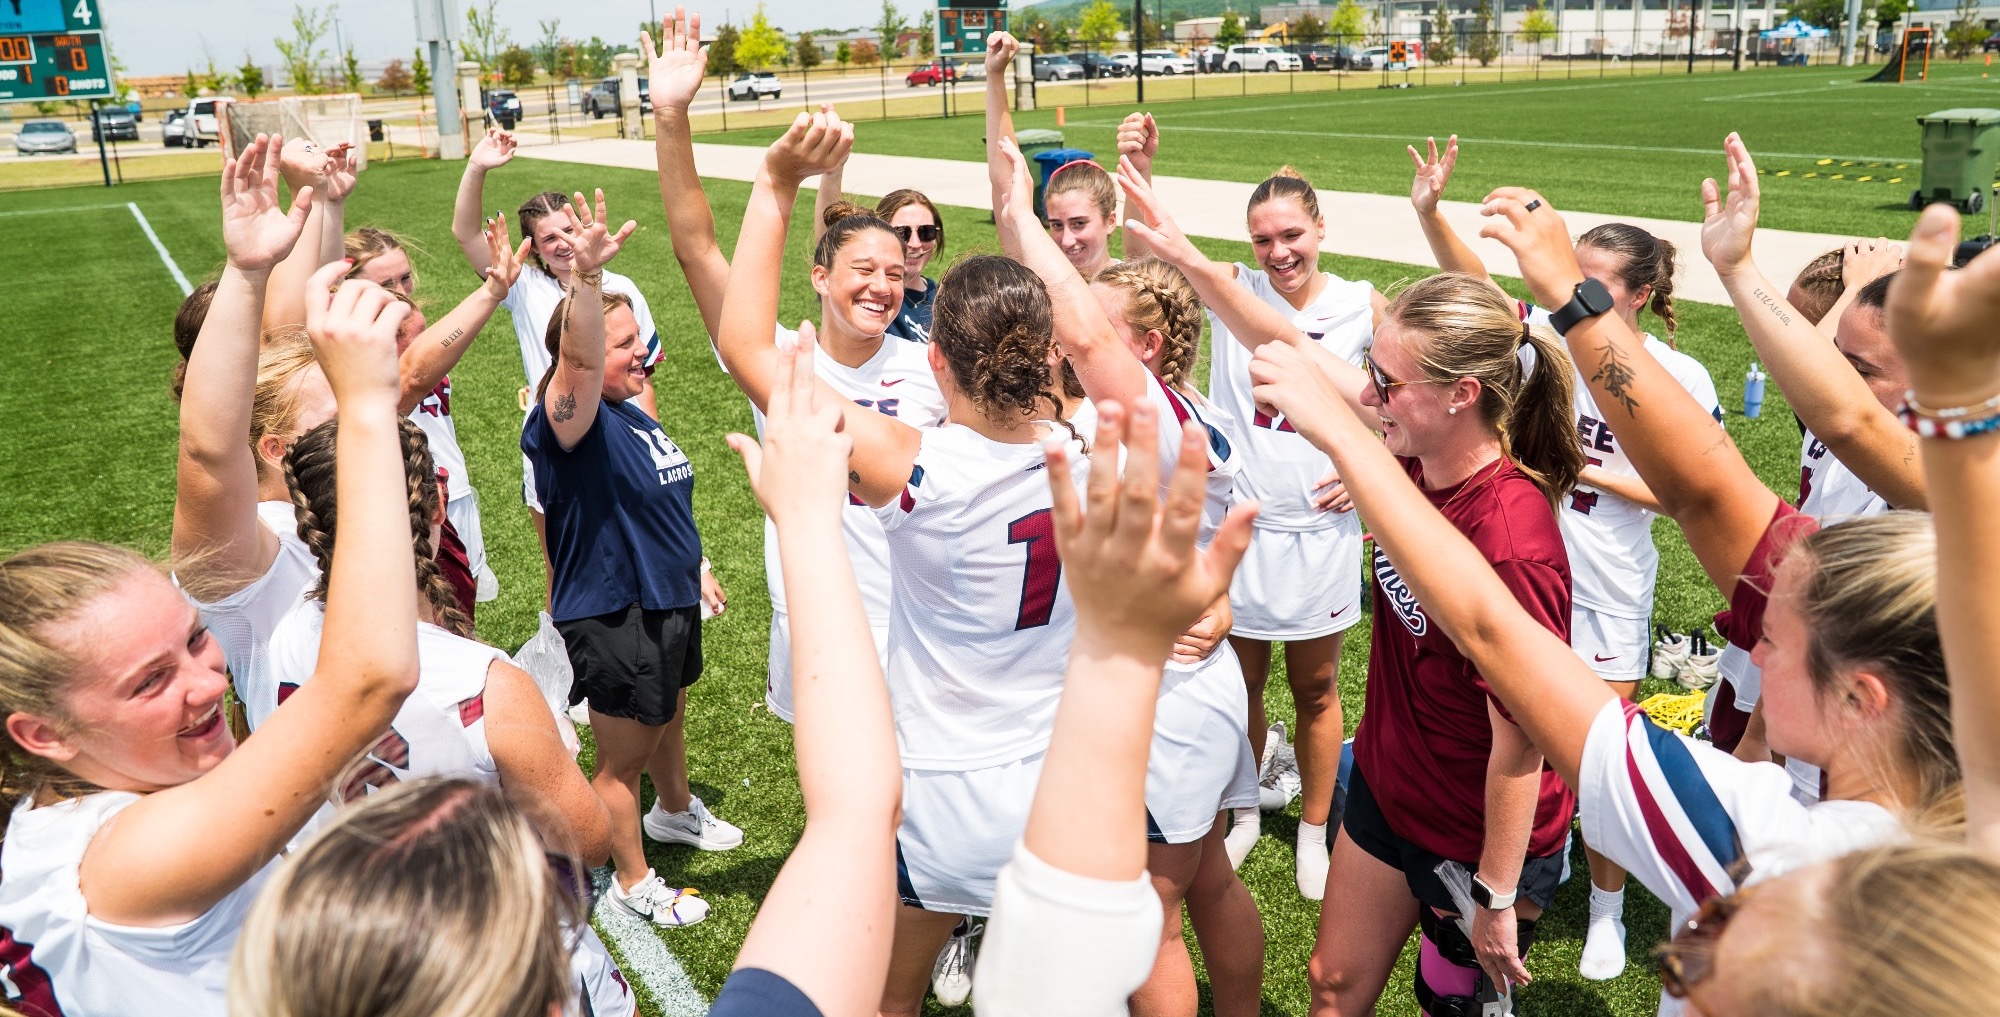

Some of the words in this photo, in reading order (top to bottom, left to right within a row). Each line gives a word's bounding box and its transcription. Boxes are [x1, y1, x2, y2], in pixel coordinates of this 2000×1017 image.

[72, 0, 92, 25] 4
[71, 47, 88, 71] 0
[54, 75, 69, 95] 0
[69, 78, 106, 90] SHOTS
[1007, 506, 1062, 631] 1
